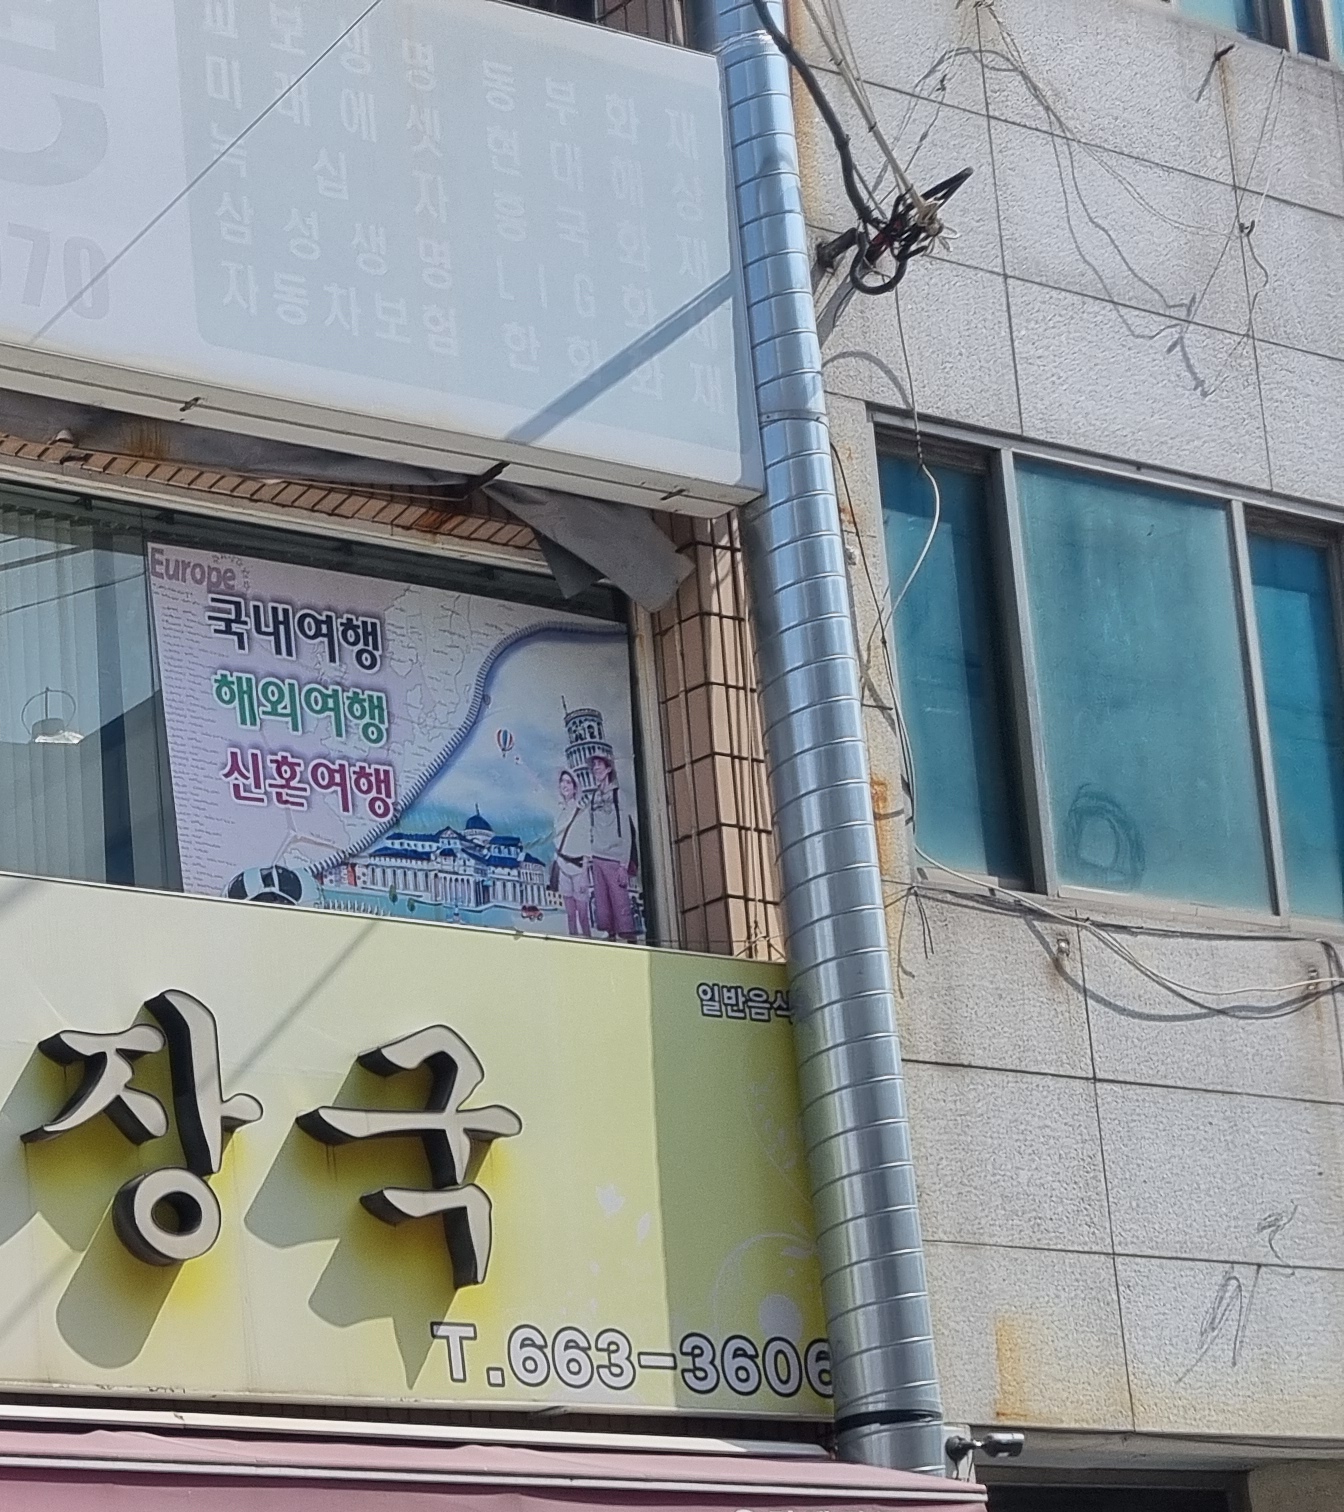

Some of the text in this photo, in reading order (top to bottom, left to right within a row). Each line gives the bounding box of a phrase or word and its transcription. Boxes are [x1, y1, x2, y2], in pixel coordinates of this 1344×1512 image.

[214, 193, 454, 292] 삼성생명
[220, 258, 461, 360] 자동차보험
[151, 549, 236, 591] Europe
[207, 598, 381, 671] 국내여행
[214, 672, 388, 745] 해외여행
[222, 748, 396, 819] 신혼여행
